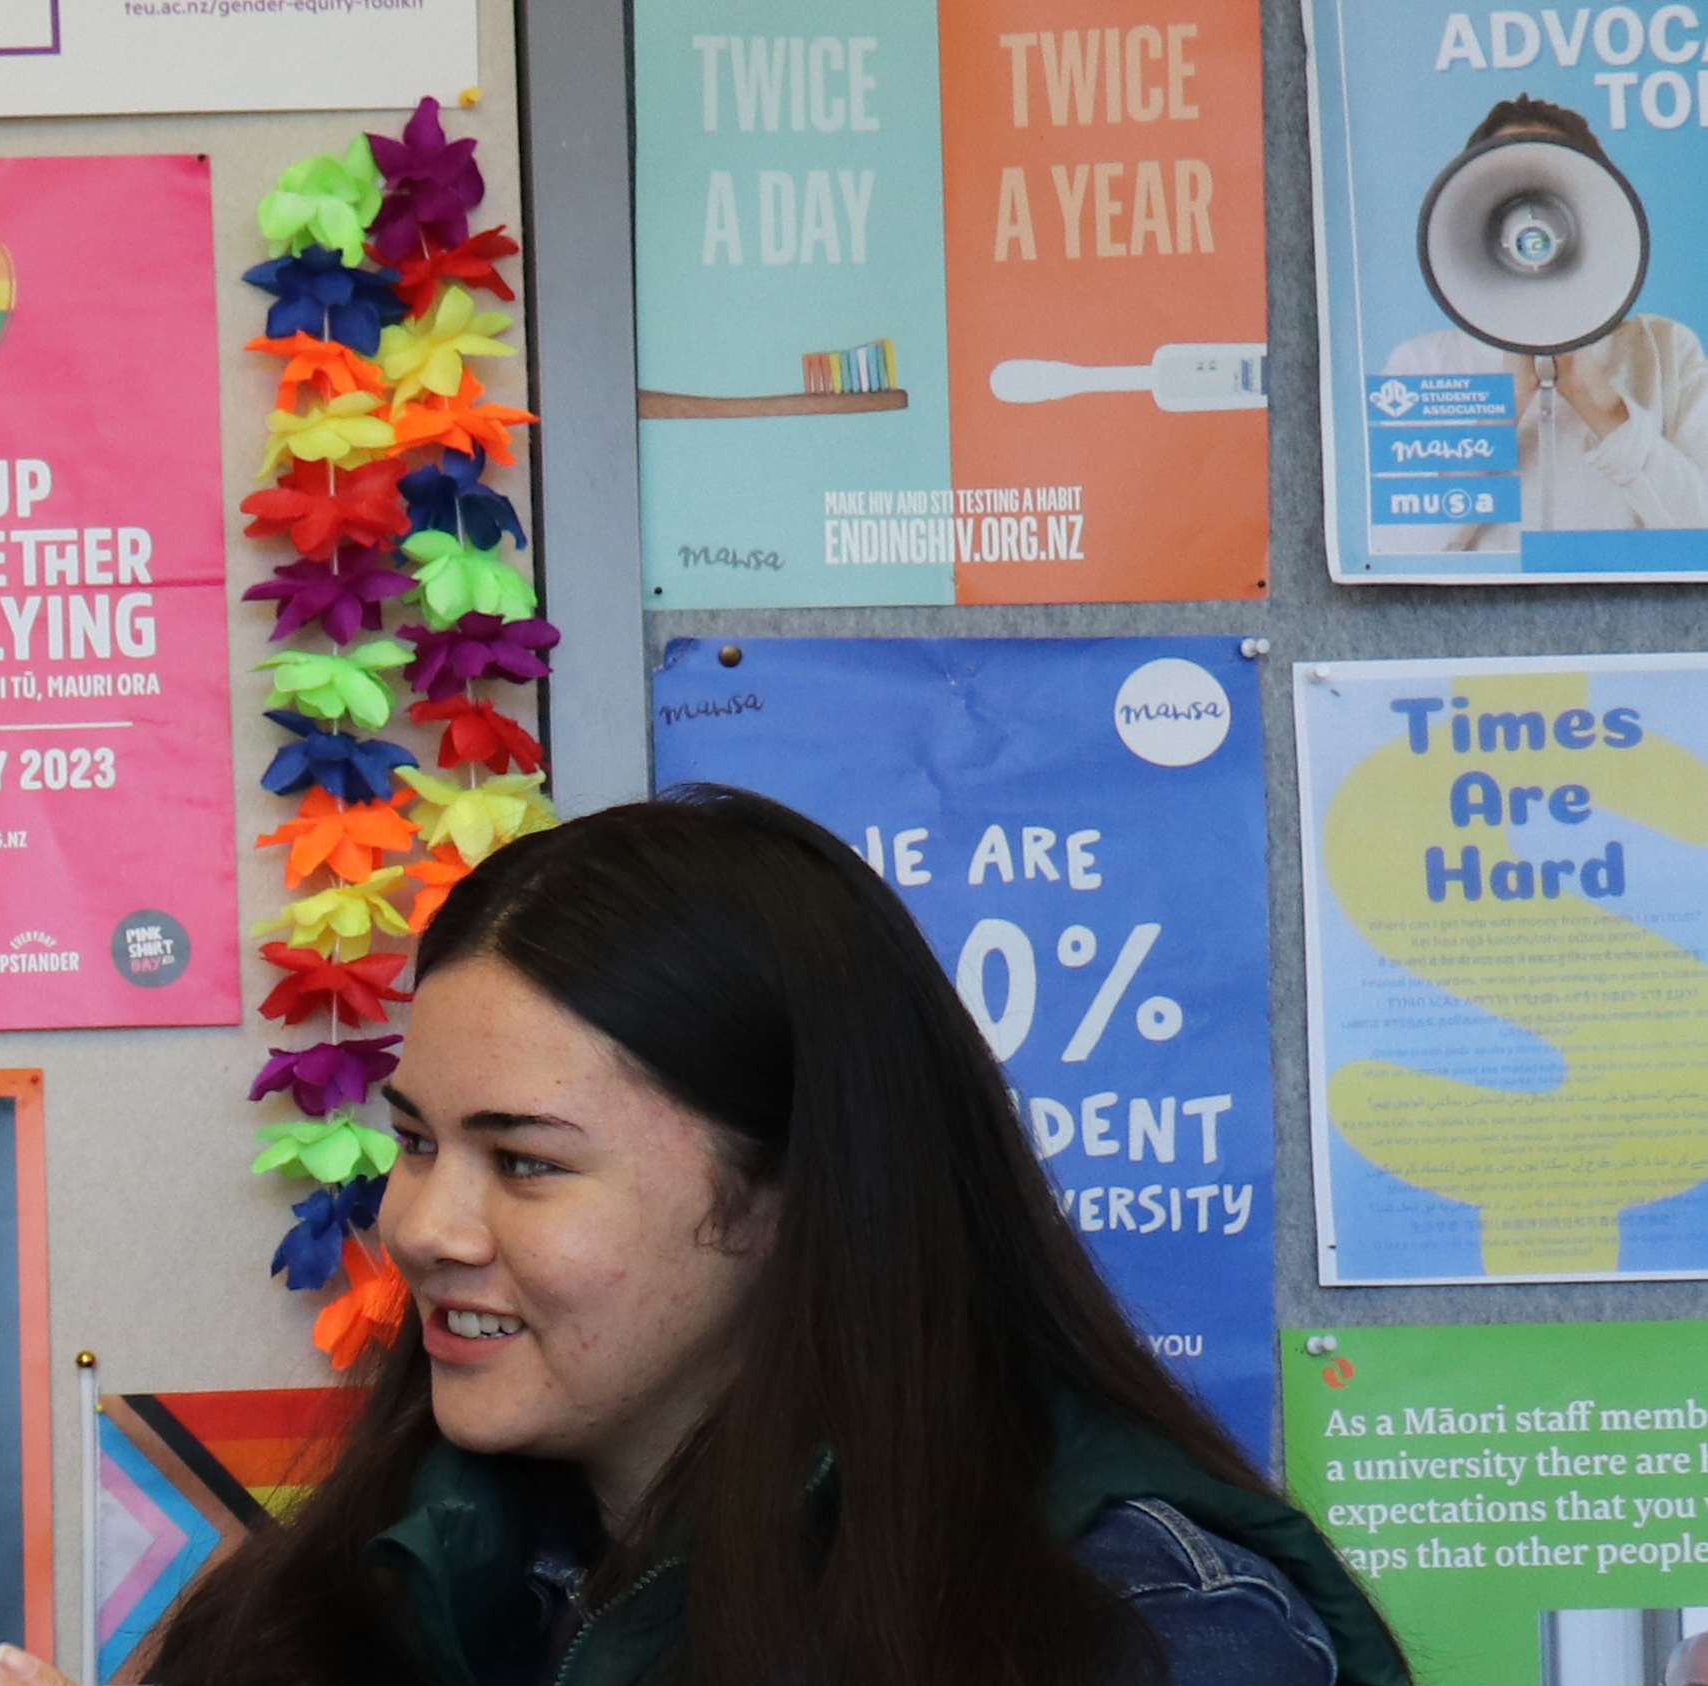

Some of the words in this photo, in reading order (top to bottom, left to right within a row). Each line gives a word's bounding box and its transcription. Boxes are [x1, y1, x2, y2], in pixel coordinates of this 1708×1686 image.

[1435, 5, 1708, 71] ADVOC
[693, 35, 880, 132] TWICE
[1000, 24, 1199, 127] TWICE
[702, 170, 743, 266] A
[760, 170, 874, 266] DAY
[995, 166, 1038, 262] A
[1052, 158, 1215, 261] YEAR
[1420, 379, 1471, 390] ALBANY
[1422, 404, 1505, 415] ASSOCIATION
[824, 492, 866, 516] MAKE
[869, 491, 894, 515] HIV
[897, 491, 928, 515] AND
[931, 490, 954, 514] STI
[957, 489, 1019, 514] TESTING
[1021, 489, 1034, 513] A
[1037, 487, 1082, 512] HABIT
[1391, 488, 1494, 518] musa
[823, 515, 1085, 566] ENDINGHIV.ORG.NZ
[11, 671, 43, 701] TŪ,
[47, 675, 113, 699] MAURI
[117, 673, 160, 696] ORA
[1390, 696, 1643, 754] Times
[20, 747, 116, 790] 2023
[1450, 770, 1592, 827] Are
[1425, 841, 1625, 902] Hard
[125, 926, 162, 943] PINK
[128, 939, 174, 958] SHIRT
[1150, 1335, 1203, 1356] YOU
[1324, 1409, 1367, 1437] As
[1376, 1415, 1395, 1435] a
[1404, 1404, 1507, 1435] Māori
[1515, 1400, 1594, 1433] staff
[1327, 1461, 1345, 1481] a
[1353, 1450, 1526, 1486] university
[1535, 1447, 1627, 1477] there
[1635, 1452, 1691, 1474] are
[1327, 1493, 1547, 1534] expectations
[1556, 1491, 1625, 1522] that
[1633, 1497, 1696, 1528] you
[1339, 1544, 1408, 1579] aps
[1417, 1537, 1487, 1569] that
[1495, 1536, 1584, 1568] other
